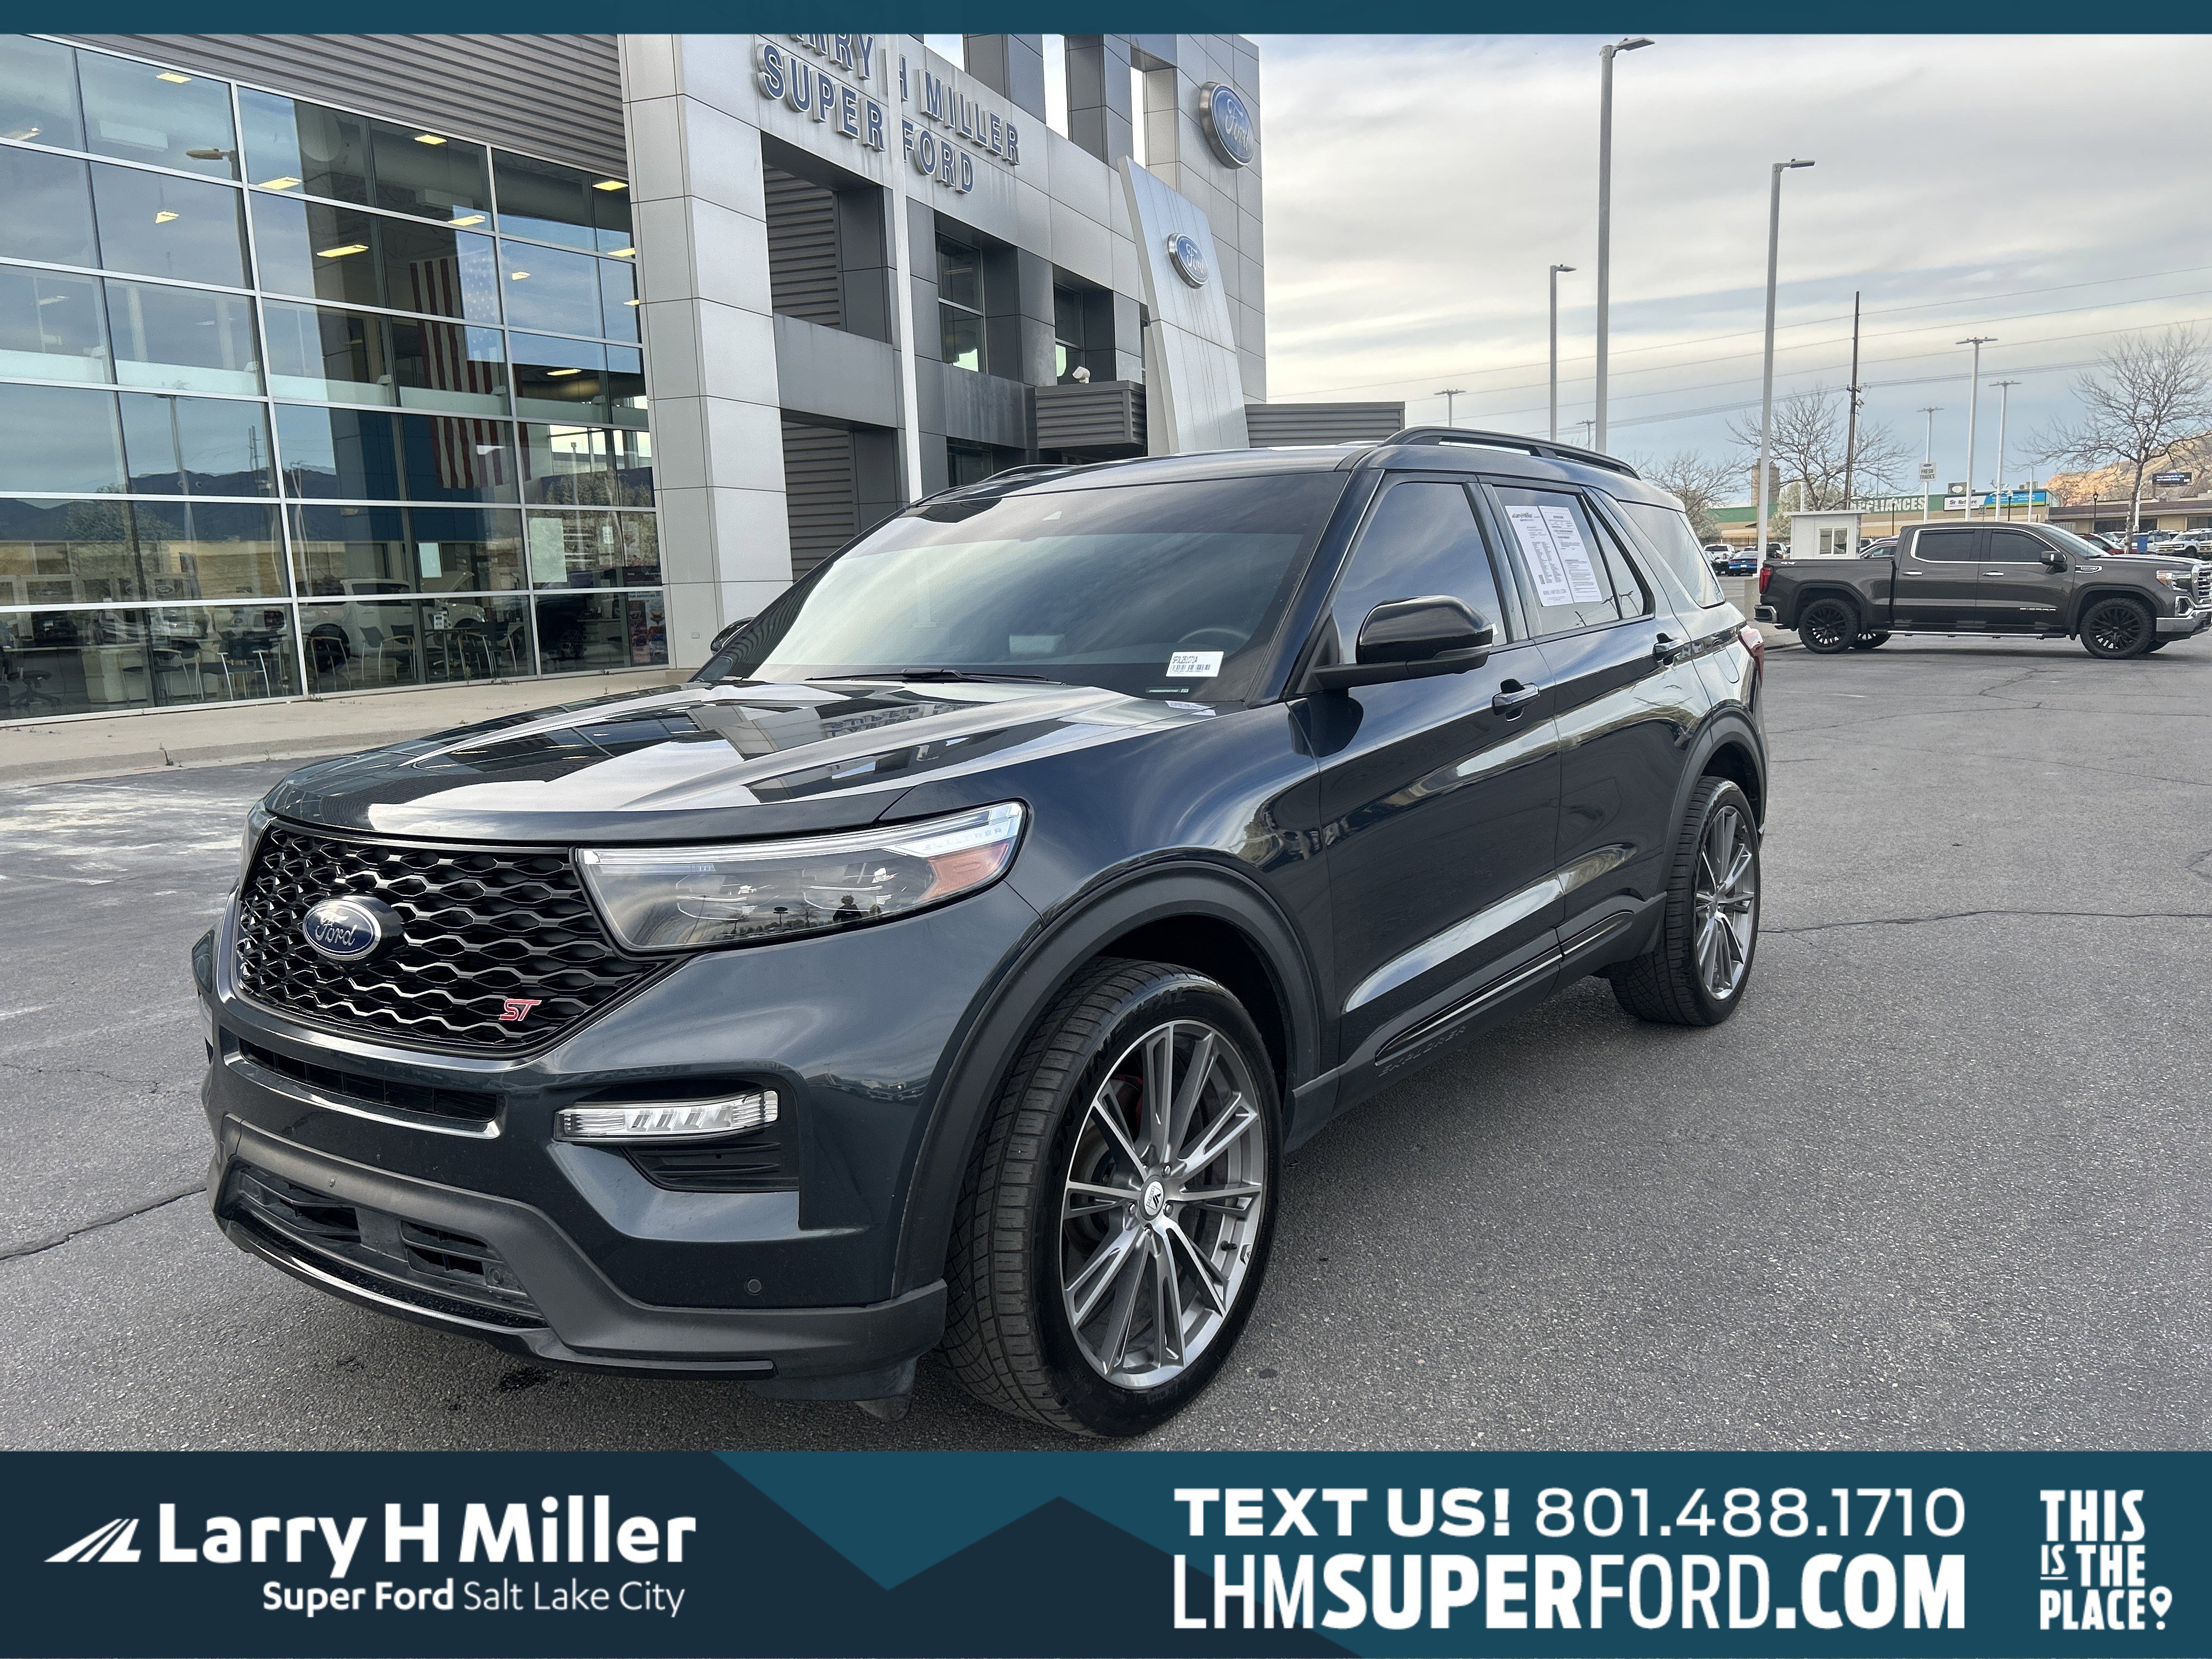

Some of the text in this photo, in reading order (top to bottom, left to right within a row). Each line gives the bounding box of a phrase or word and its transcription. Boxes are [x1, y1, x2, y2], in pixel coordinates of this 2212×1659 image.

[758, 42, 974, 194] SUPER FORD
[919, 69, 1021, 165] MILLER
[1225, 98, 1249, 151] Ford
[1186, 242, 1205, 275] Ford
[314, 911, 359, 947] Ford
[498, 998, 542, 1022] ST
